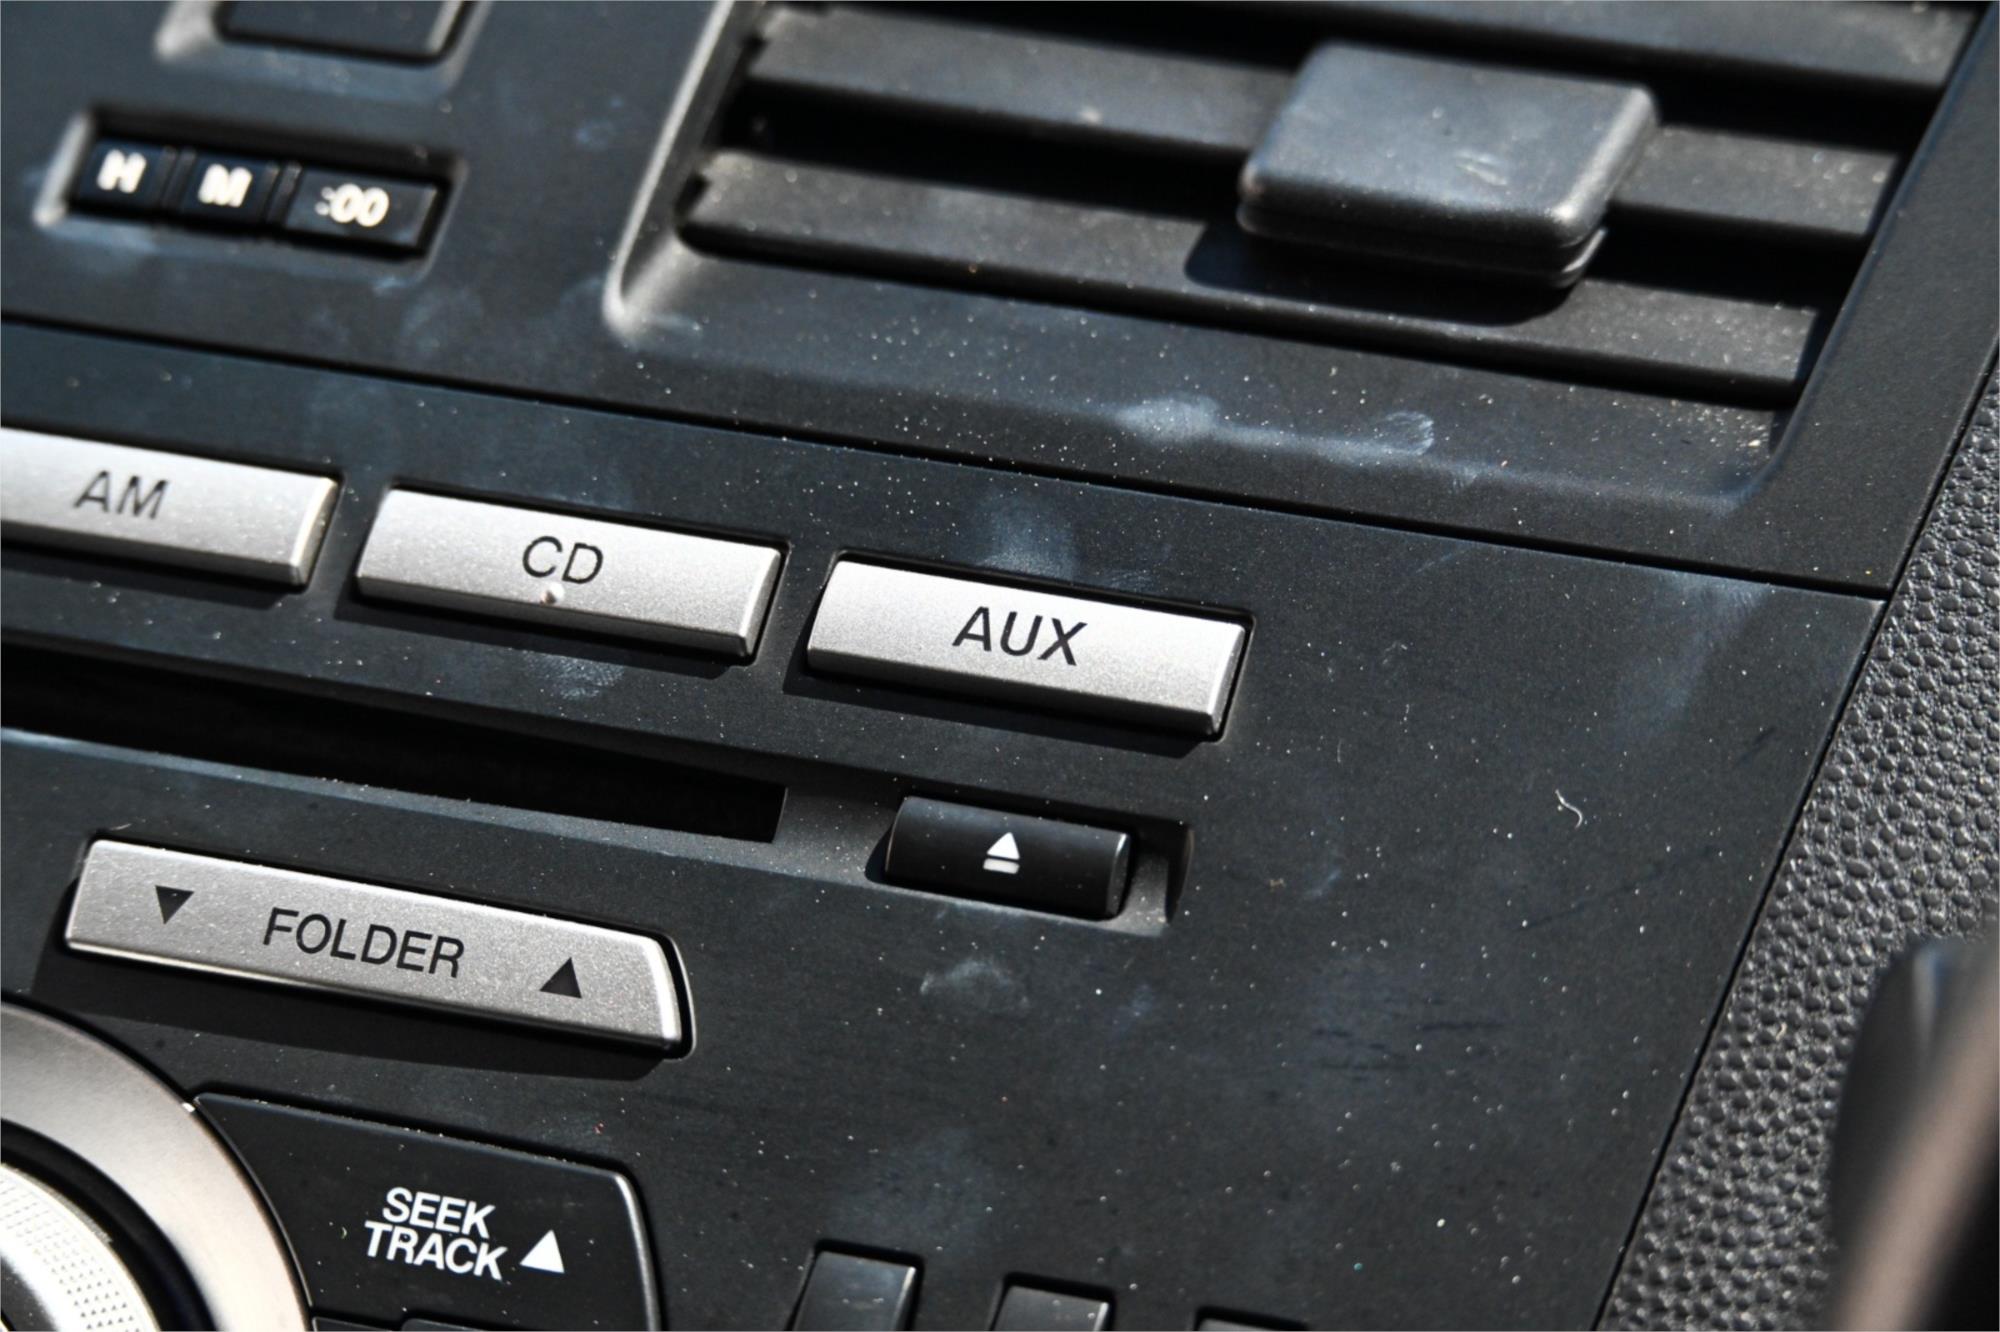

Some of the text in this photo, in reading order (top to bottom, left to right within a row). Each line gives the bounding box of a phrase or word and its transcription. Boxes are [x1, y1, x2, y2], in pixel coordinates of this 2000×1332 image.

[97, 150, 146, 193] H
[198, 165, 252, 207] M
[317, 184, 389, 226] :00
[74, 471, 168, 519] AM
[521, 535, 605, 584] CD
[953, 606, 1086, 666] AUX
[262, 906, 465, 979] FOLDER
[382, 1186, 496, 1239] SEEK
[364, 1220, 508, 1281] TRACK
